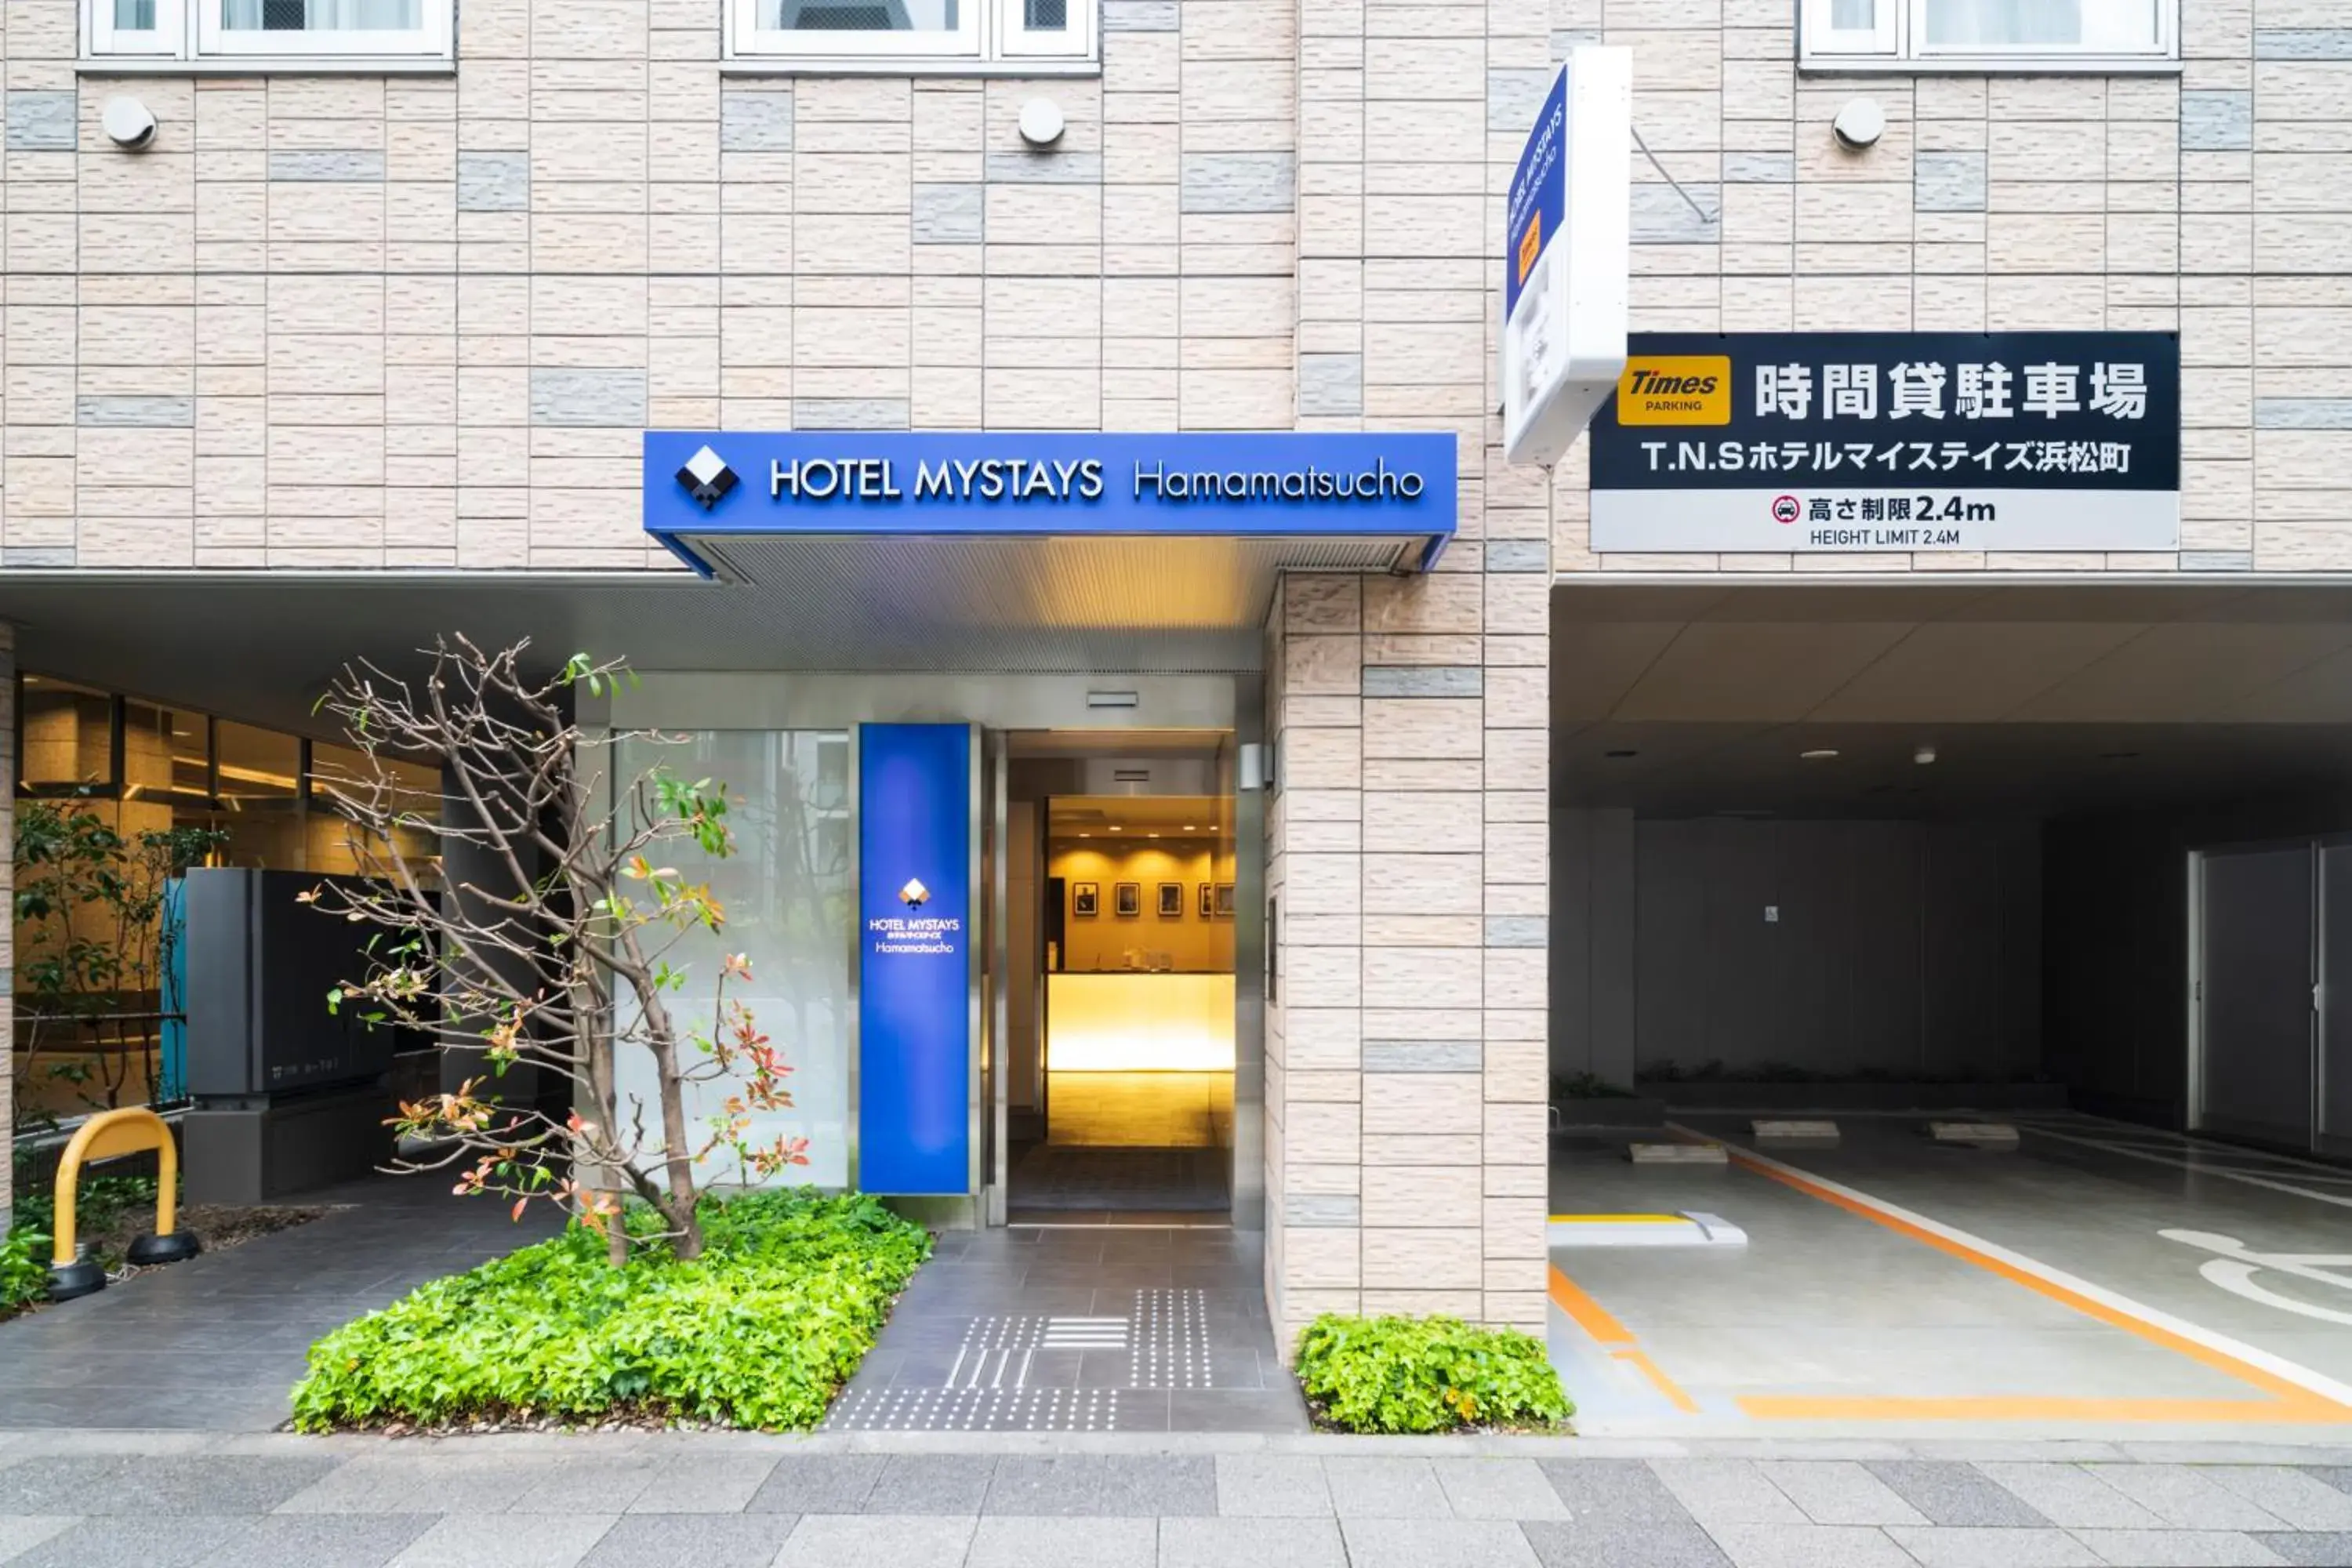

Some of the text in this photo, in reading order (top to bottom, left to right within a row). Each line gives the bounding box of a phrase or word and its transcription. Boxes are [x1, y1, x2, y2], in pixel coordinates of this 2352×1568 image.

[1630, 370, 1718, 394] Times
[1755, 361, 2147, 419] 時間貸駐車場
[1646, 401, 1702, 412] PARKING
[1641, 441, 2132, 473] T.N.Sホテルマイステイズ浜松町
[770, 456, 1424, 496] HOTEL MYSTAYS Hamamatsucho
[1811, 530, 1959, 544] HEIGHT LIMIT 2.4M
[869, 919, 959, 930] HOTEL MYSTAYS
